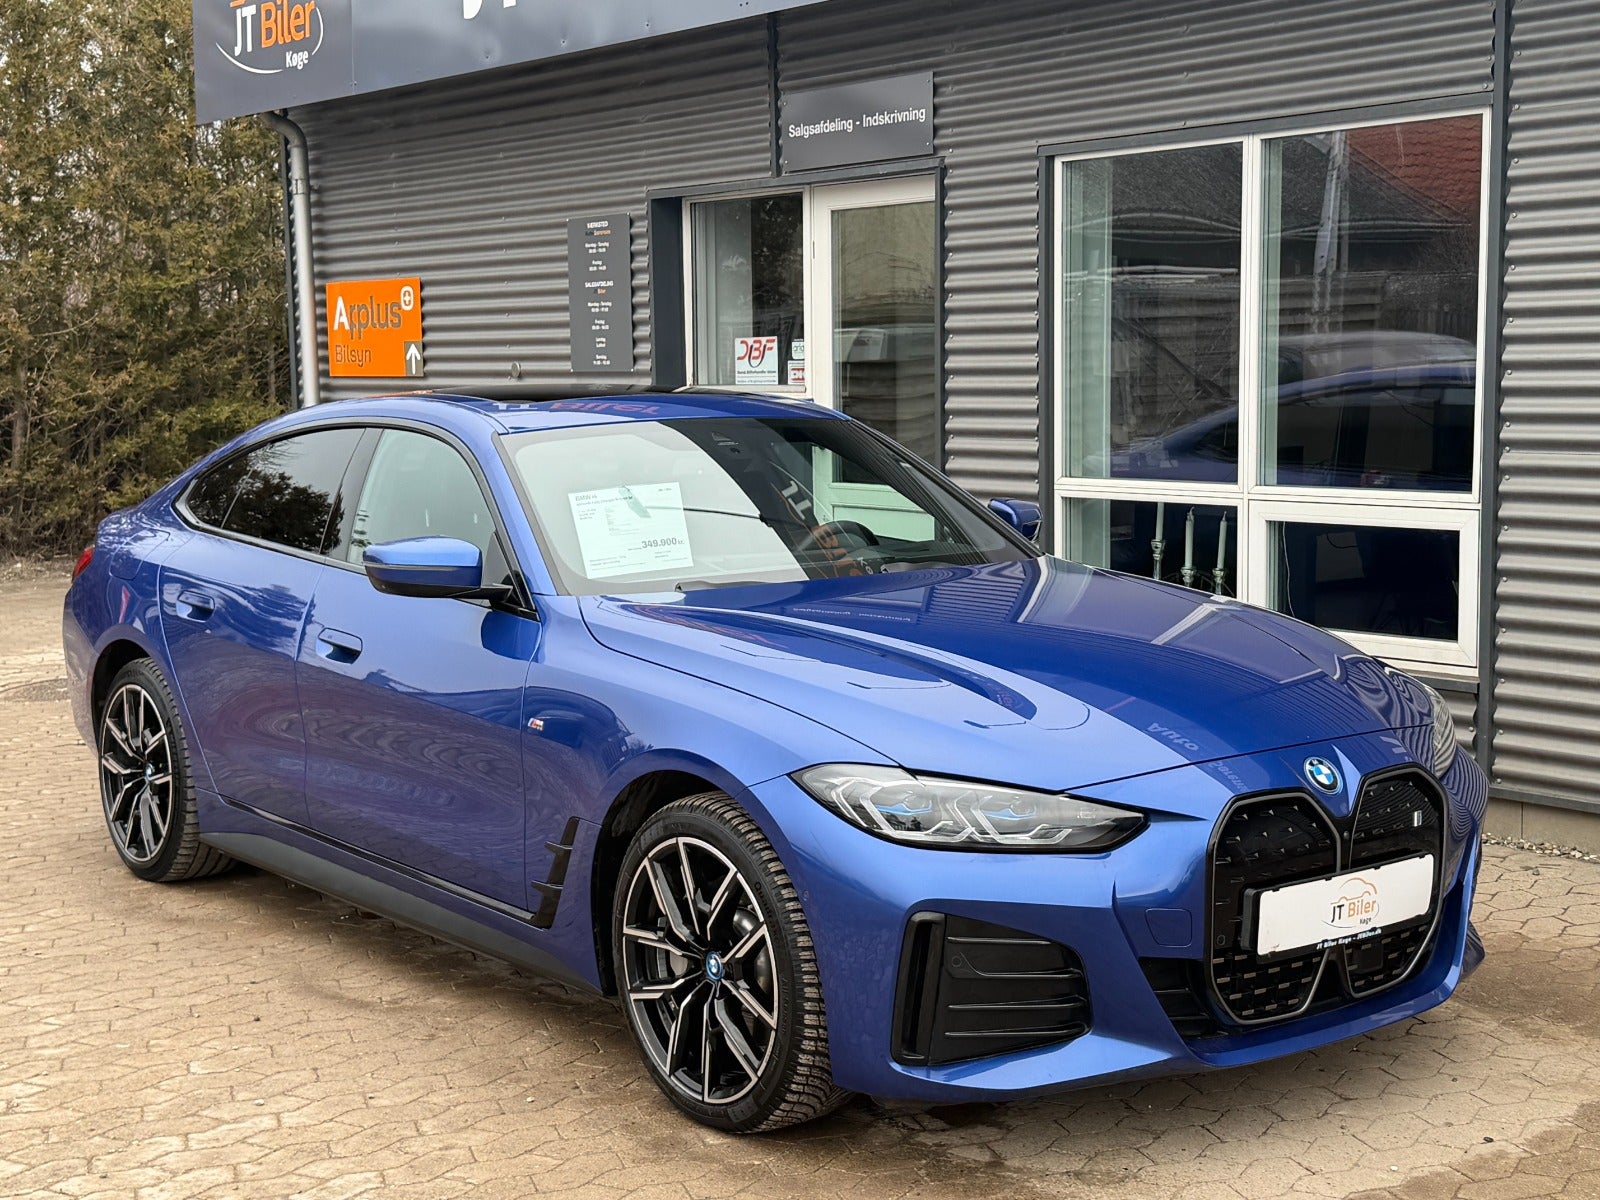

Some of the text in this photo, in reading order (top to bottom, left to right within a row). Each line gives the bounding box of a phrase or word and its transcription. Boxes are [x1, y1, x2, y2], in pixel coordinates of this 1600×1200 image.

[234, 0, 316, 57] JT Biler
[285, 50, 309, 69] Køge
[788, 118, 853, 139] Salgsafdeling
[862, 107, 926, 128] Indskrivning
[333, 296, 402, 340] Applus
[335, 345, 372, 367] Bilsyn
[641, 537, 677, 549] 349.900
[1331, 899, 1377, 923] JT Biler
